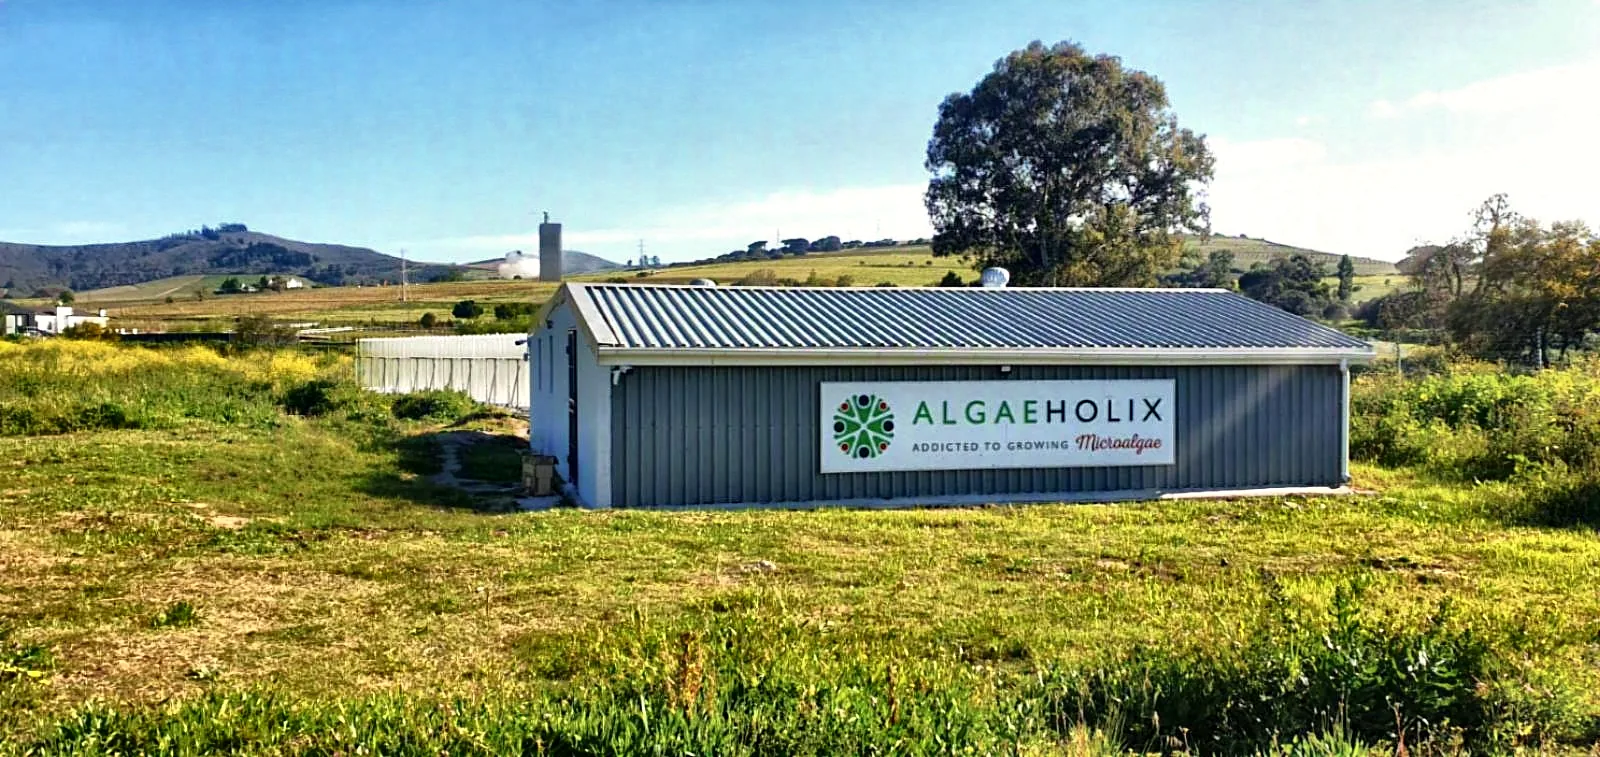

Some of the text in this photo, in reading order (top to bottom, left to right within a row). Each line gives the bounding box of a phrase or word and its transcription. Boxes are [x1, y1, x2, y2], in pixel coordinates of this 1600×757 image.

[912, 398, 1163, 425] ALGAEHOLIX
[912, 433, 1163, 455] ADDICTED TO GROWING Microalgae
